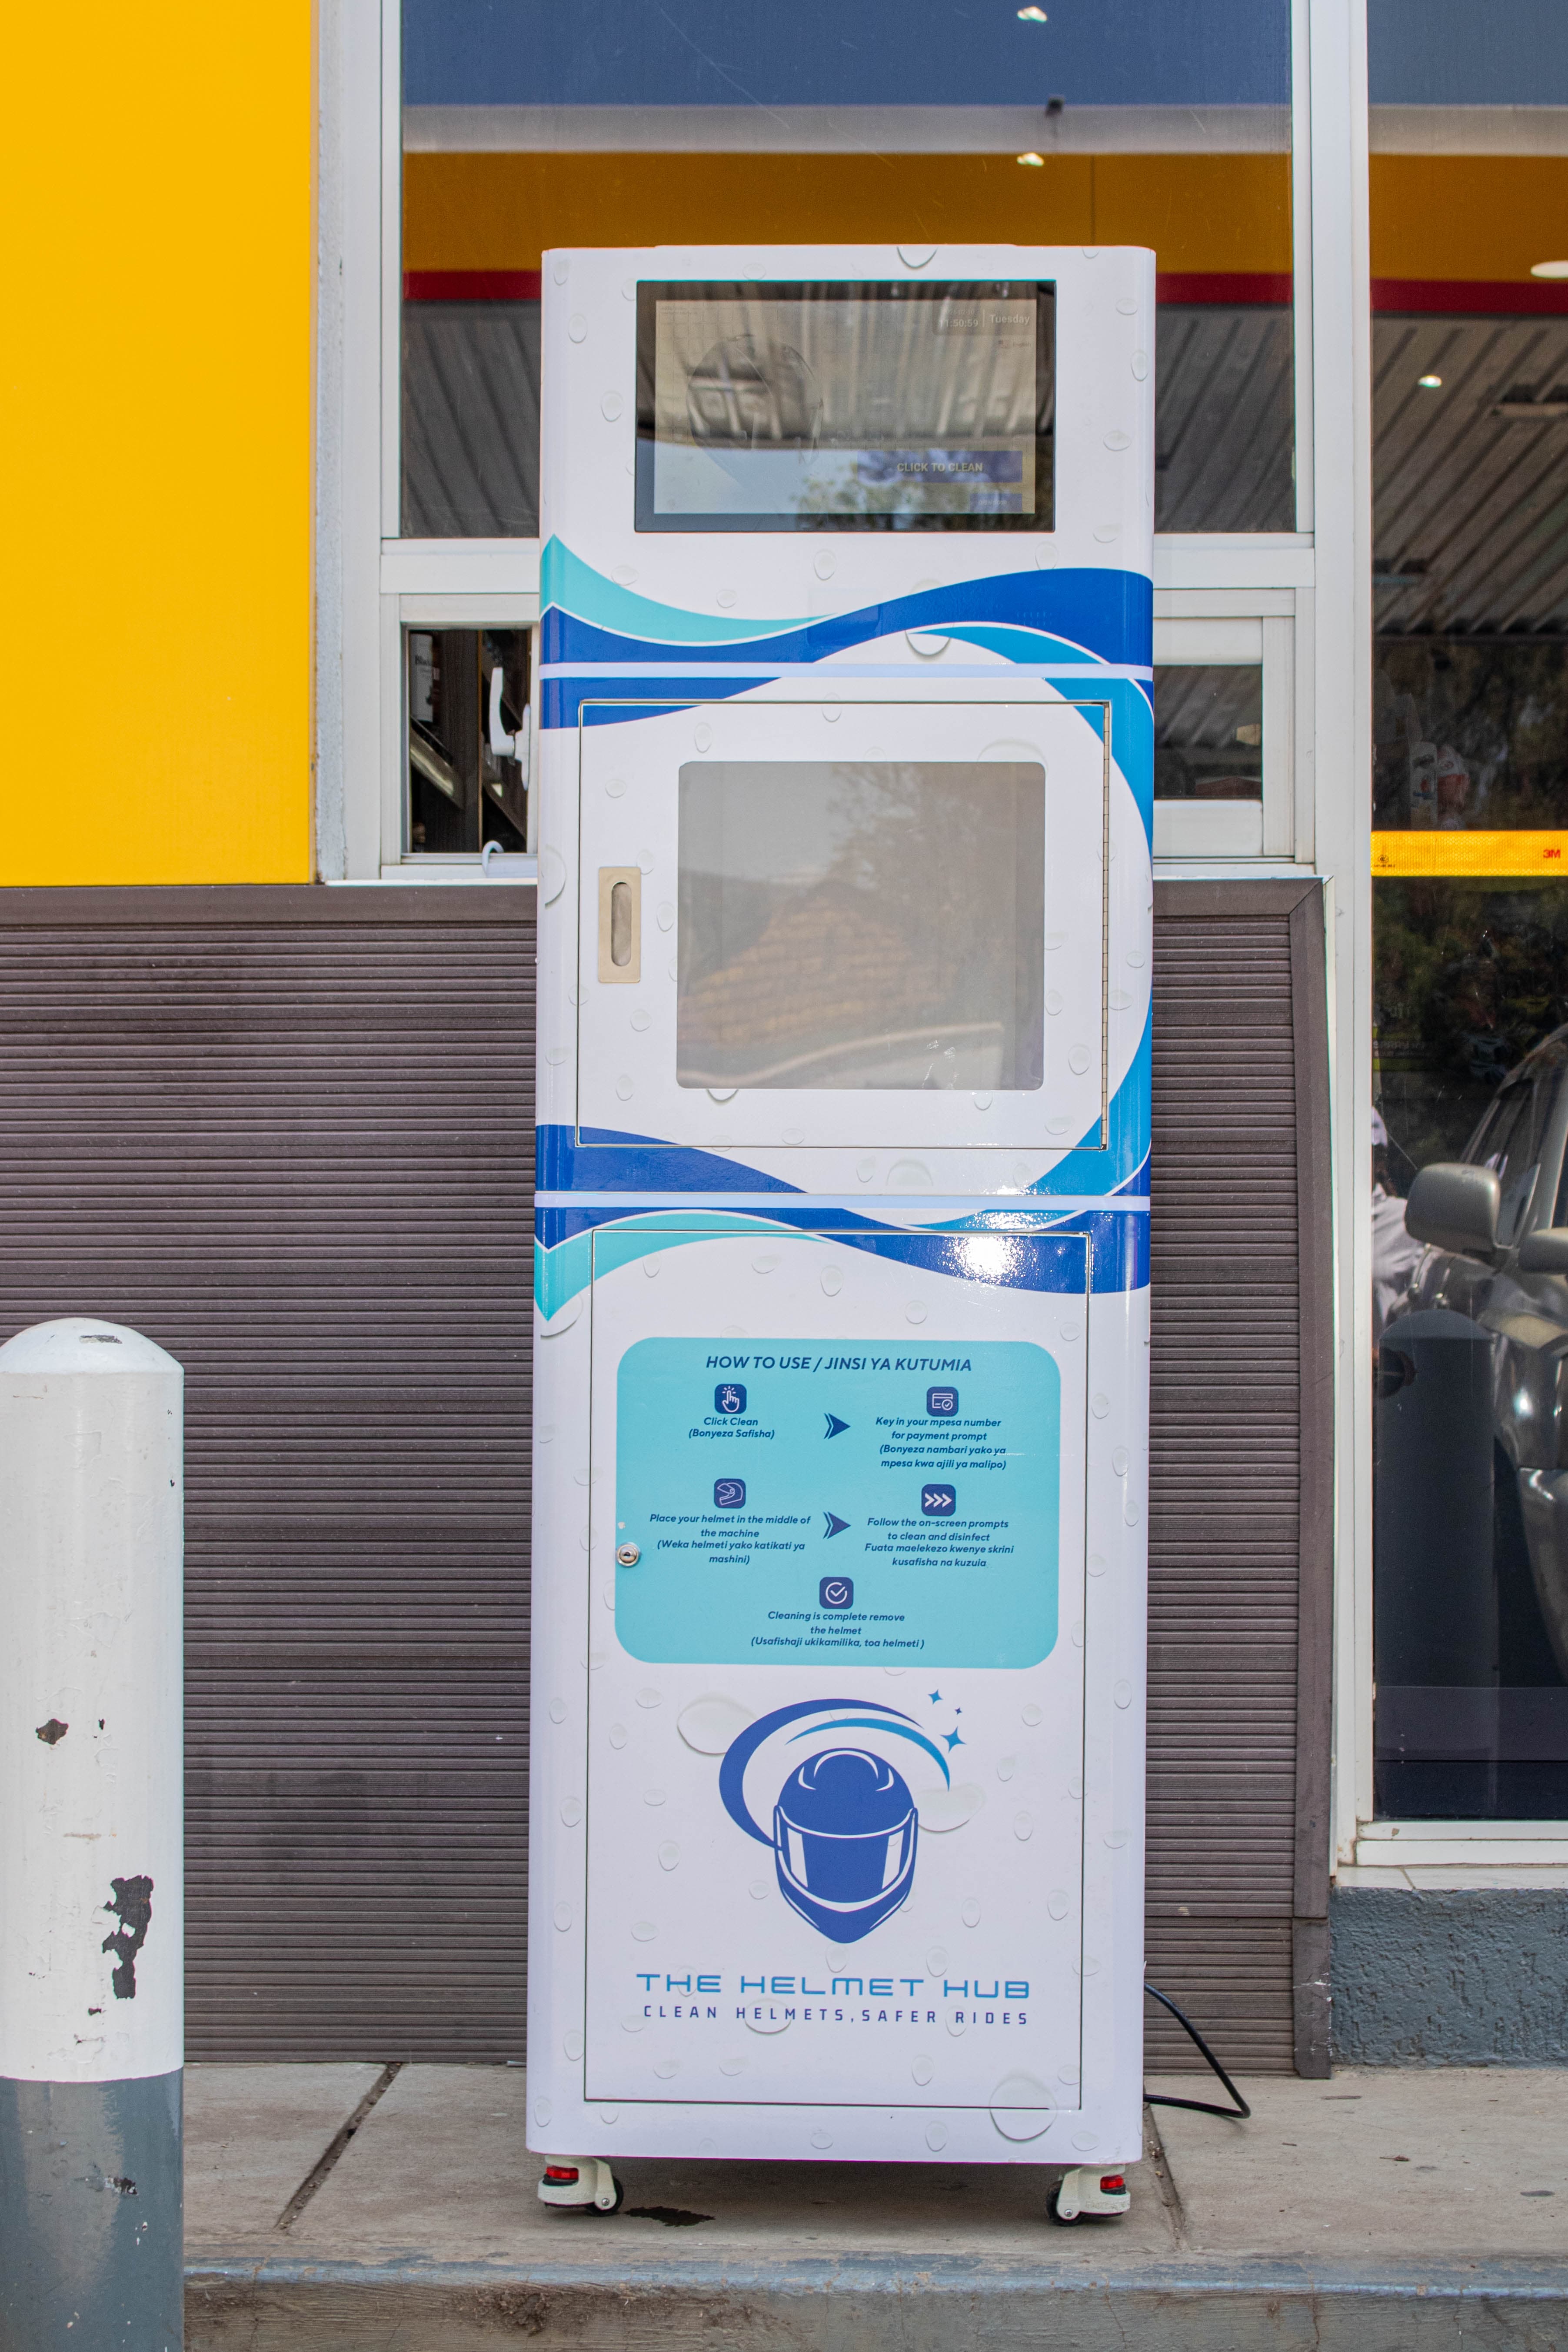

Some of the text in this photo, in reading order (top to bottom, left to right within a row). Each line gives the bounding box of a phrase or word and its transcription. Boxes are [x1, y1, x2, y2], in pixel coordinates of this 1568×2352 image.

[990, 314, 1030, 325] Tuesday
[897, 462, 983, 472] CLICK TO CLEAN
[1543, 850, 1560, 858] 3M
[706, 1356, 750, 1368] HOW
[754, 1357, 775, 1368] TO
[779, 1357, 812, 1369] USE
[824, 1357, 866, 1370] JINSI
[871, 1358, 890, 1370] YA
[895, 1358, 971, 1371] KUTUMIA
[876, 1417, 895, 1427] Key
[689, 1429, 774, 1440] (Bonyeza Safisha)
[906, 1433, 949, 1441] payment
[951, 1433, 987, 1442] prompt
[880, 1444, 925, 1454] (Bonyeza
[969, 1446, 992, 1456] yako
[936, 1460, 954, 1469] ajili
[970, 1460, 1006, 1470] malipo)
[968, 1520, 1009, 1529] prompts
[657, 1540, 689, 1550] (Weka
[729, 1541, 752, 1550] yako
[865, 1543, 893, 1551] Fuata
[949, 1545, 986, 1554] kwenye
[709, 1555, 749, 1565] mashini)
[768, 1611, 811, 1621] Cleaning
[823, 1613, 867, 1622] complete
[751, 1637, 802, 1647] (Usafishaji
[805, 1638, 861, 1647] ukikamilika,
[636, 1973, 1030, 1999] THE HELMET HUB
[644, 2006, 716, 2018] CLEAN
[955, 2012, 1026, 2025] RIDES
